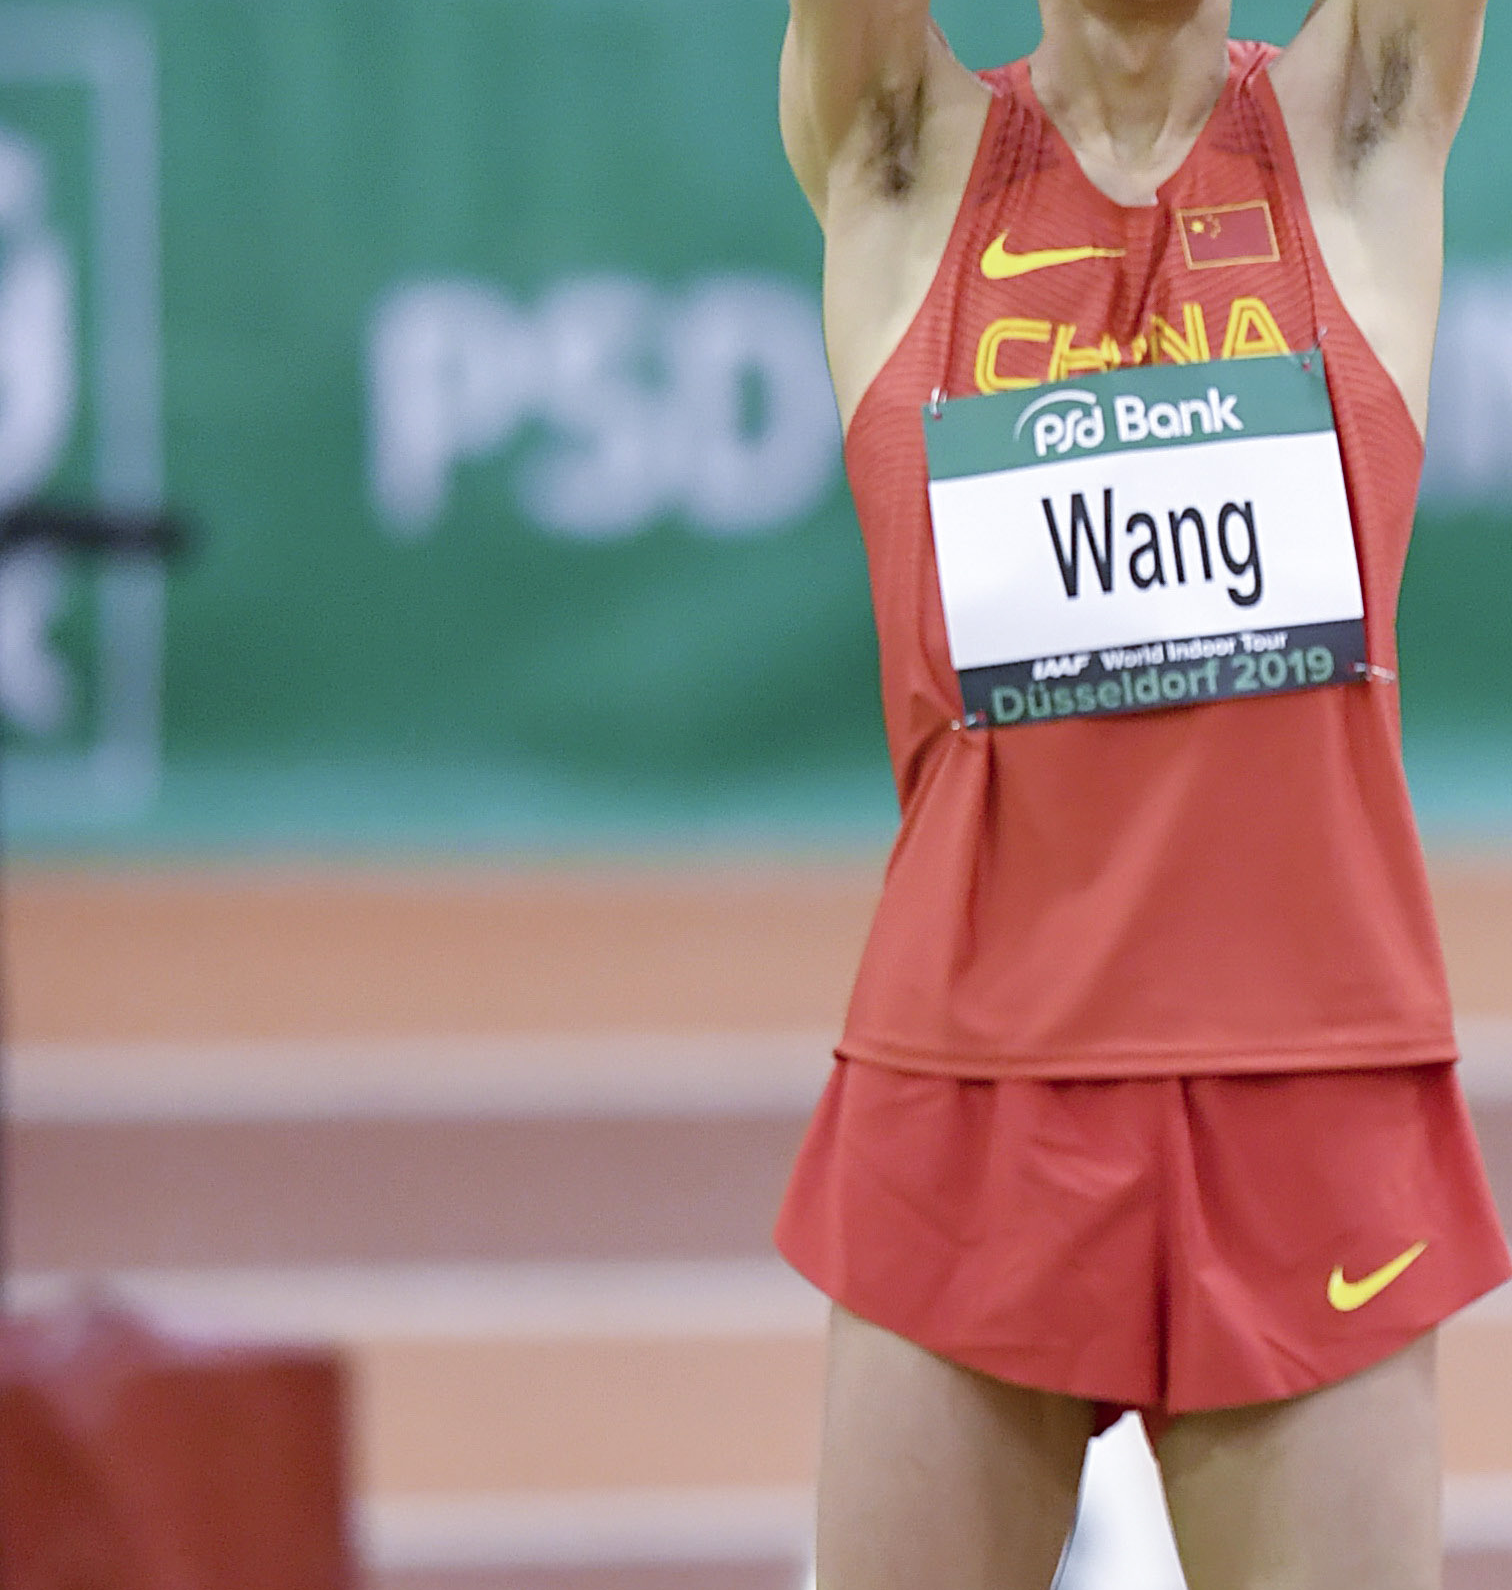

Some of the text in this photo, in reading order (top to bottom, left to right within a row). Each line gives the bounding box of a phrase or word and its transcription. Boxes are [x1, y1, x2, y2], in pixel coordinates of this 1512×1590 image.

[975, 297, 1292, 394] CHNA
[372, 275, 845, 539] PSD
[1114, 387, 1244, 442] Bank
[1041, 488, 1263, 608] Wang
[991, 645, 1336, 725] Düsseldorf 2019
[1100, 643, 1165, 671] World
[1166, 636, 1237, 662] Indoor
[1241, 630, 1289, 653] Tour
